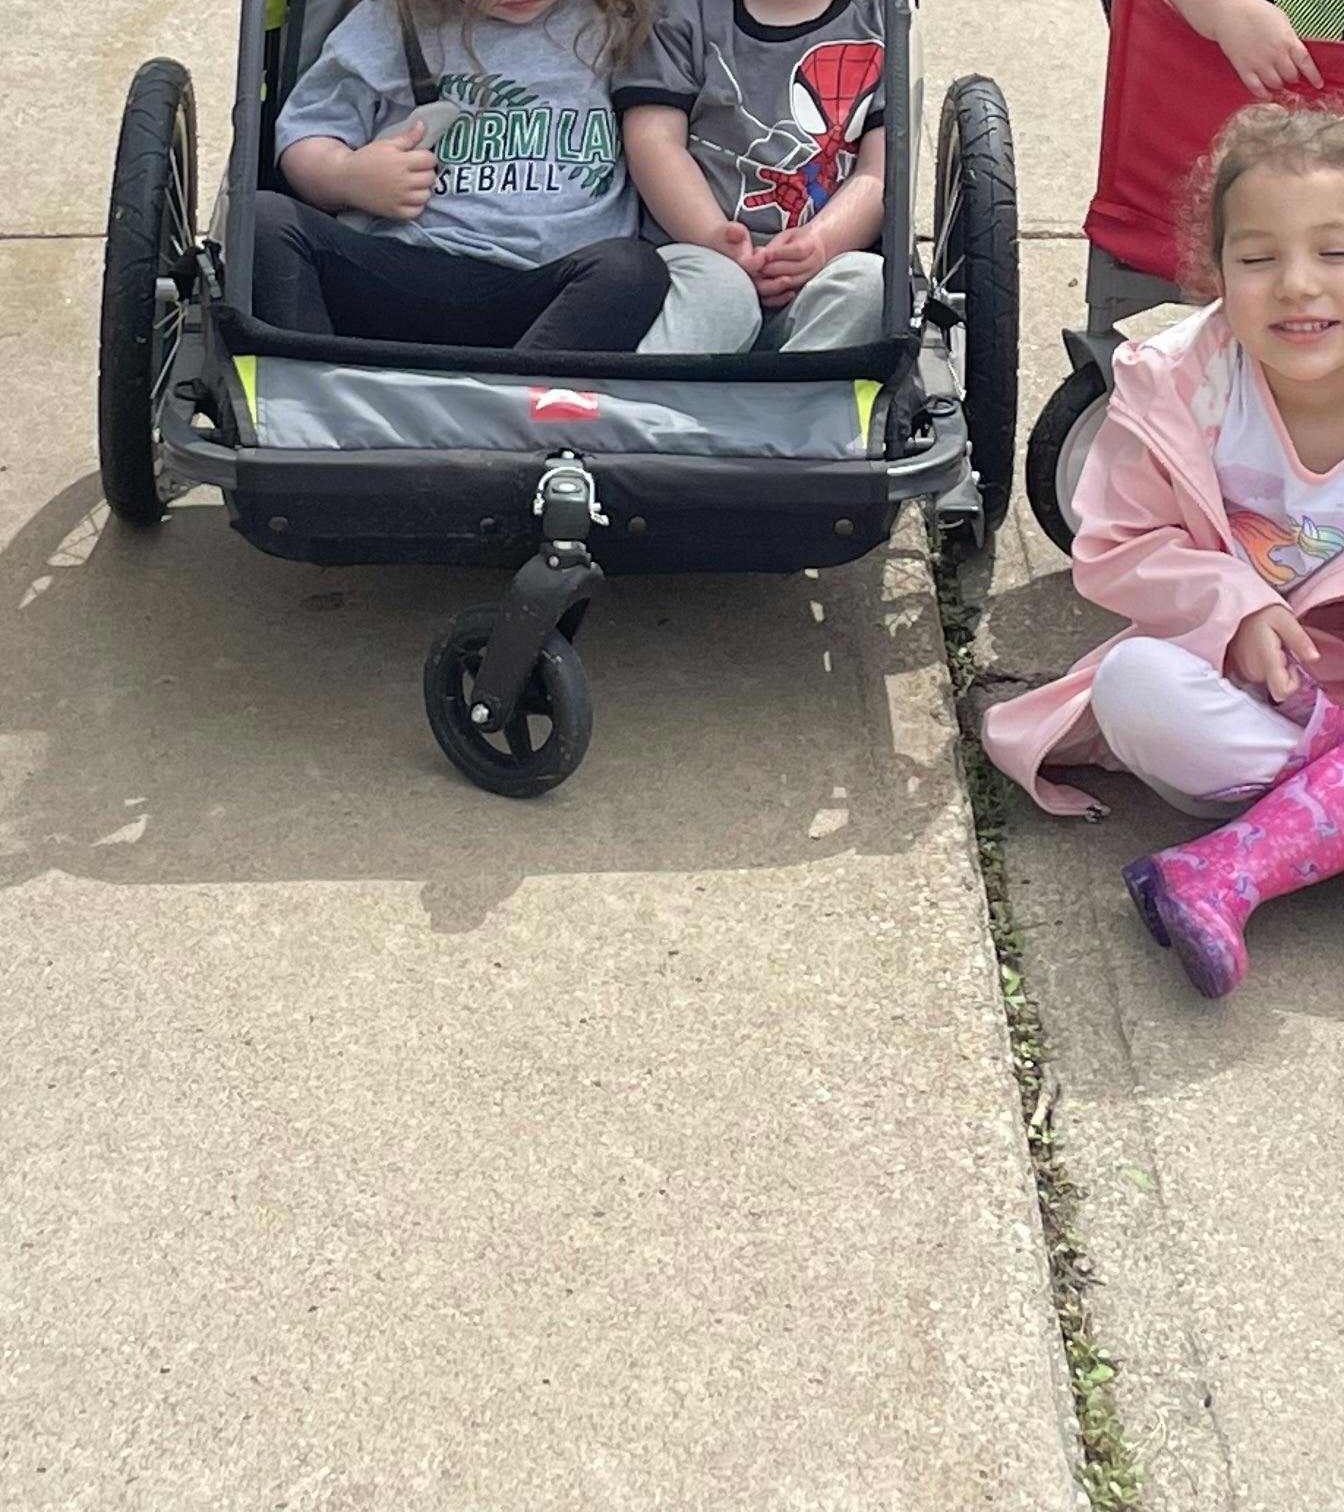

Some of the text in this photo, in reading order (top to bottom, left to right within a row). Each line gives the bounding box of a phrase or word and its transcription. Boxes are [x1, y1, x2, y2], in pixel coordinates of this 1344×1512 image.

[437, 107, 620, 165] ORM LA
[434, 160, 563, 196] SEBALL
